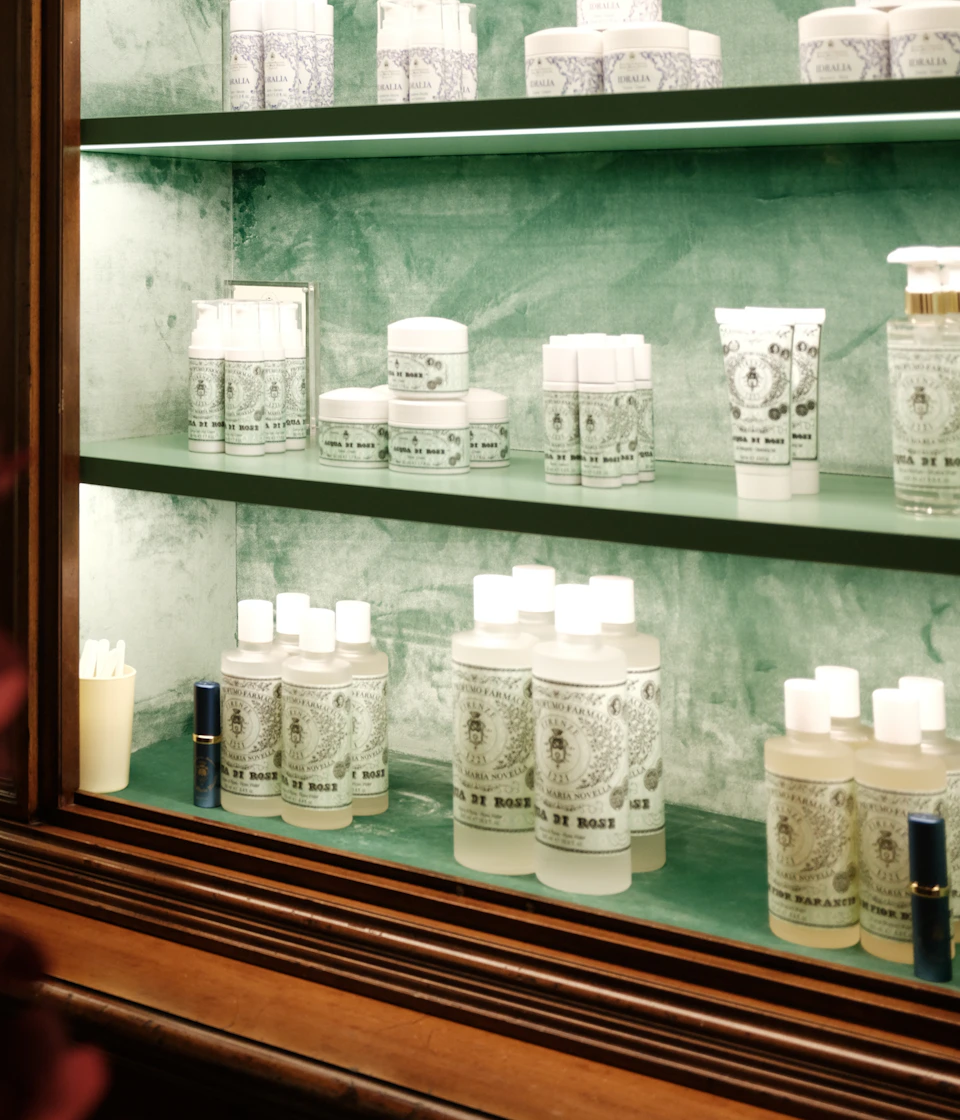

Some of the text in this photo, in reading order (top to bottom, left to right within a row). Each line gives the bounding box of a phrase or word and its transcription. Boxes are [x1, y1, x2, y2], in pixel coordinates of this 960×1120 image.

[816, 63, 852, 72] IDRALIA
[909, 58, 947, 67] IDRALIA
[617, 75, 650, 84] IDRALIA
[922, 457, 937, 467] DI
[459, 701, 496, 718] FIRENZE
[541, 718, 579, 735] FIRENZE
[229, 740, 246, 749] 1221
[228, 748, 276, 762] MARIA NOVELLA
[466, 752, 487, 764] 1221
[306, 760, 336, 772] NOVELLA
[233, 769, 279, 781] DI ROSE
[362, 768, 386, 780] ROSE
[465, 764, 528, 781] MARIA NOVELLA
[547, 771, 570, 783] 1221
[292, 779, 338, 792] DI ROSE
[546, 784, 613, 800] MARIA NOVELLA
[471, 793, 532, 809] DI ROSE
[553, 813, 616, 830] DI ROSE
[799, 868, 836, 881] NOVELLA
[876, 869, 900, 881] 1221
[876, 885, 902, 896] MARIA
[870, 903, 897, 919] FIOR
